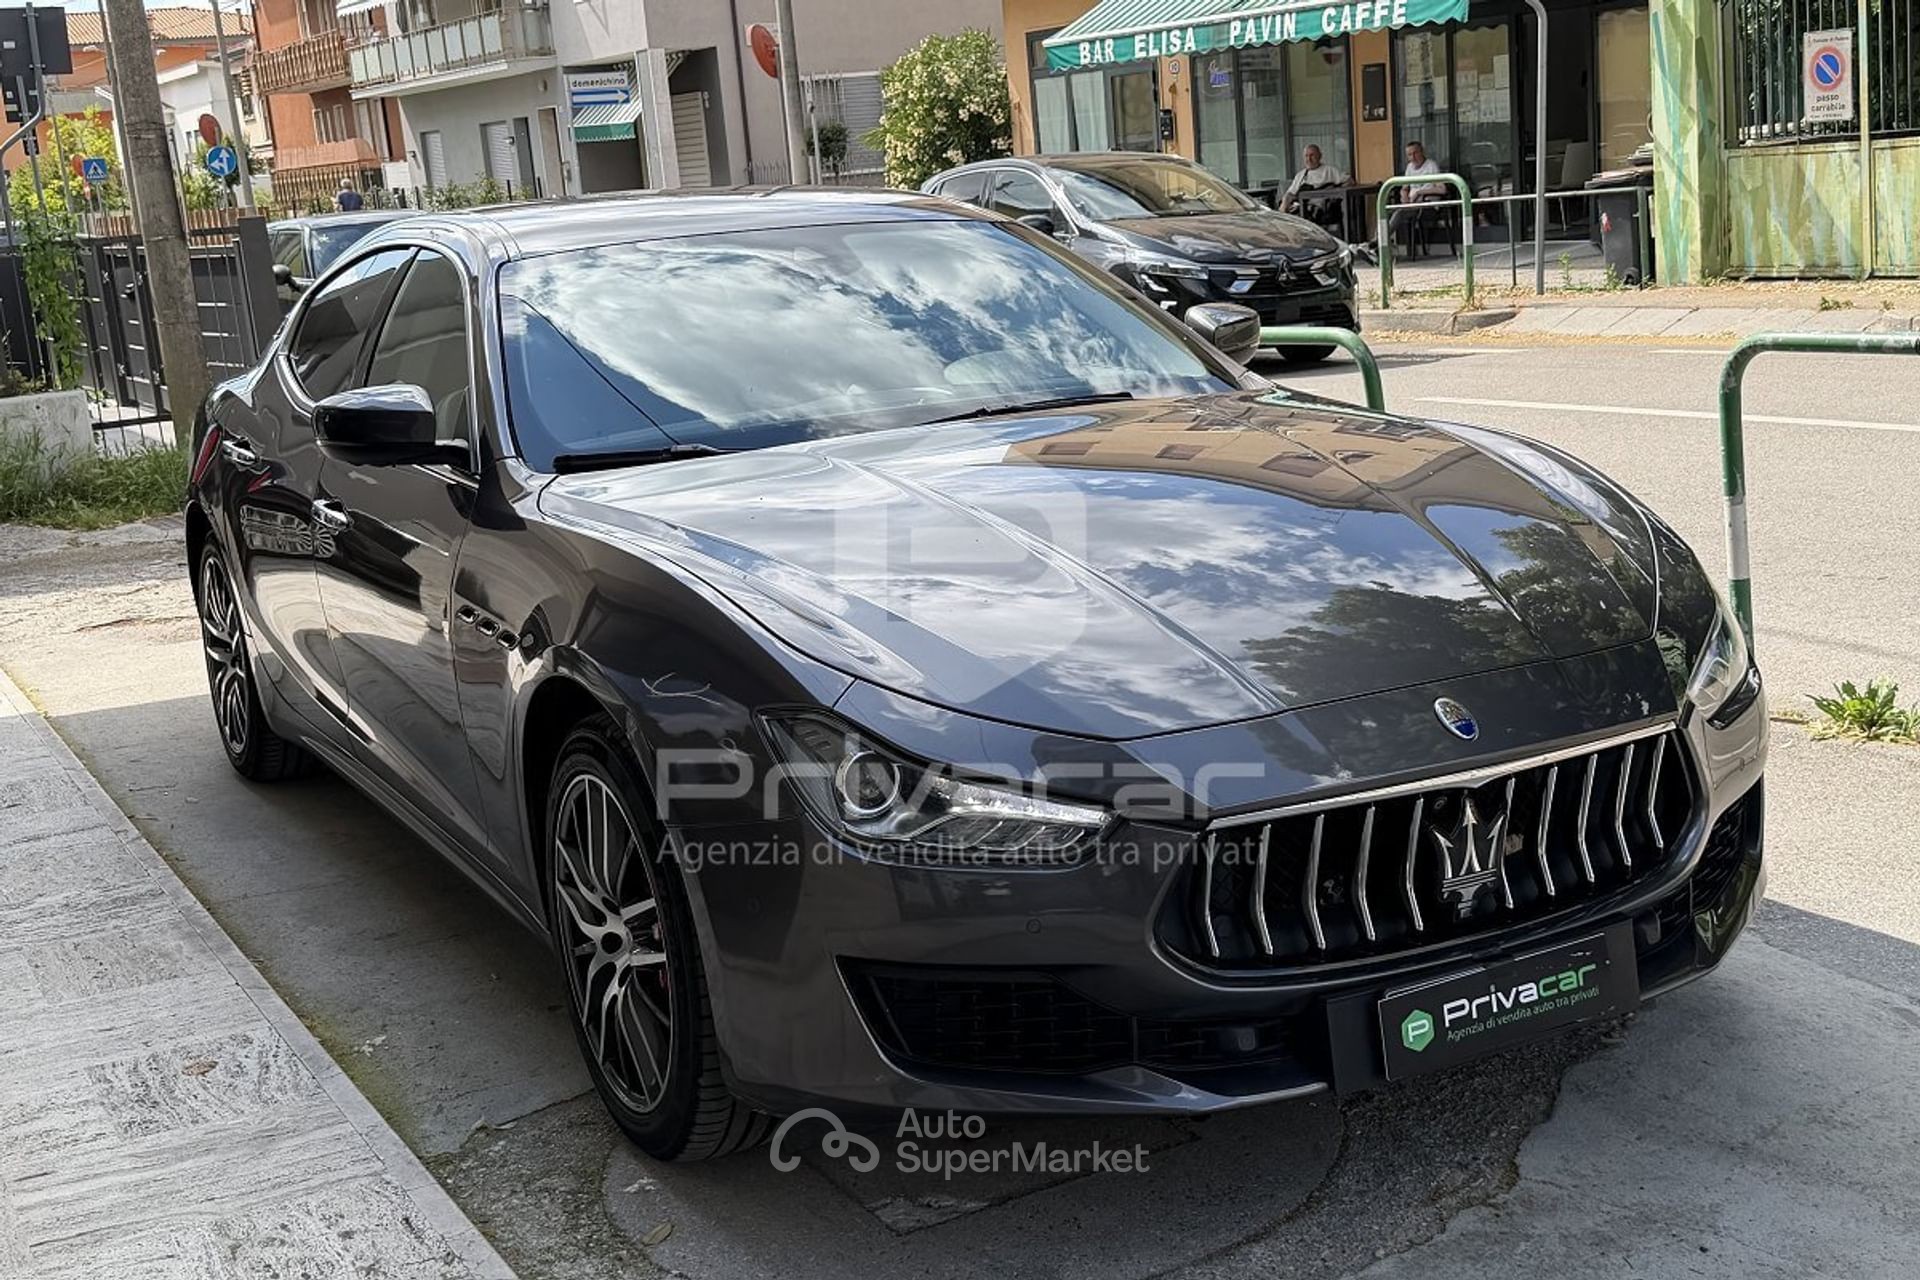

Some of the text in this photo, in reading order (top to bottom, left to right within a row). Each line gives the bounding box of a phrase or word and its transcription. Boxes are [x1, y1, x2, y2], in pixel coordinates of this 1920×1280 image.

[1079, 0, 1407, 65] BAR ELISA PAVIN CAFFE
[1811, 103, 1846, 112] carrabile
[1816, 94, 1840, 103] passo
[1443, 963, 1597, 1027] Privacar
[1447, 987, 1600, 1041] Agenzia di vendita auto tra privati
